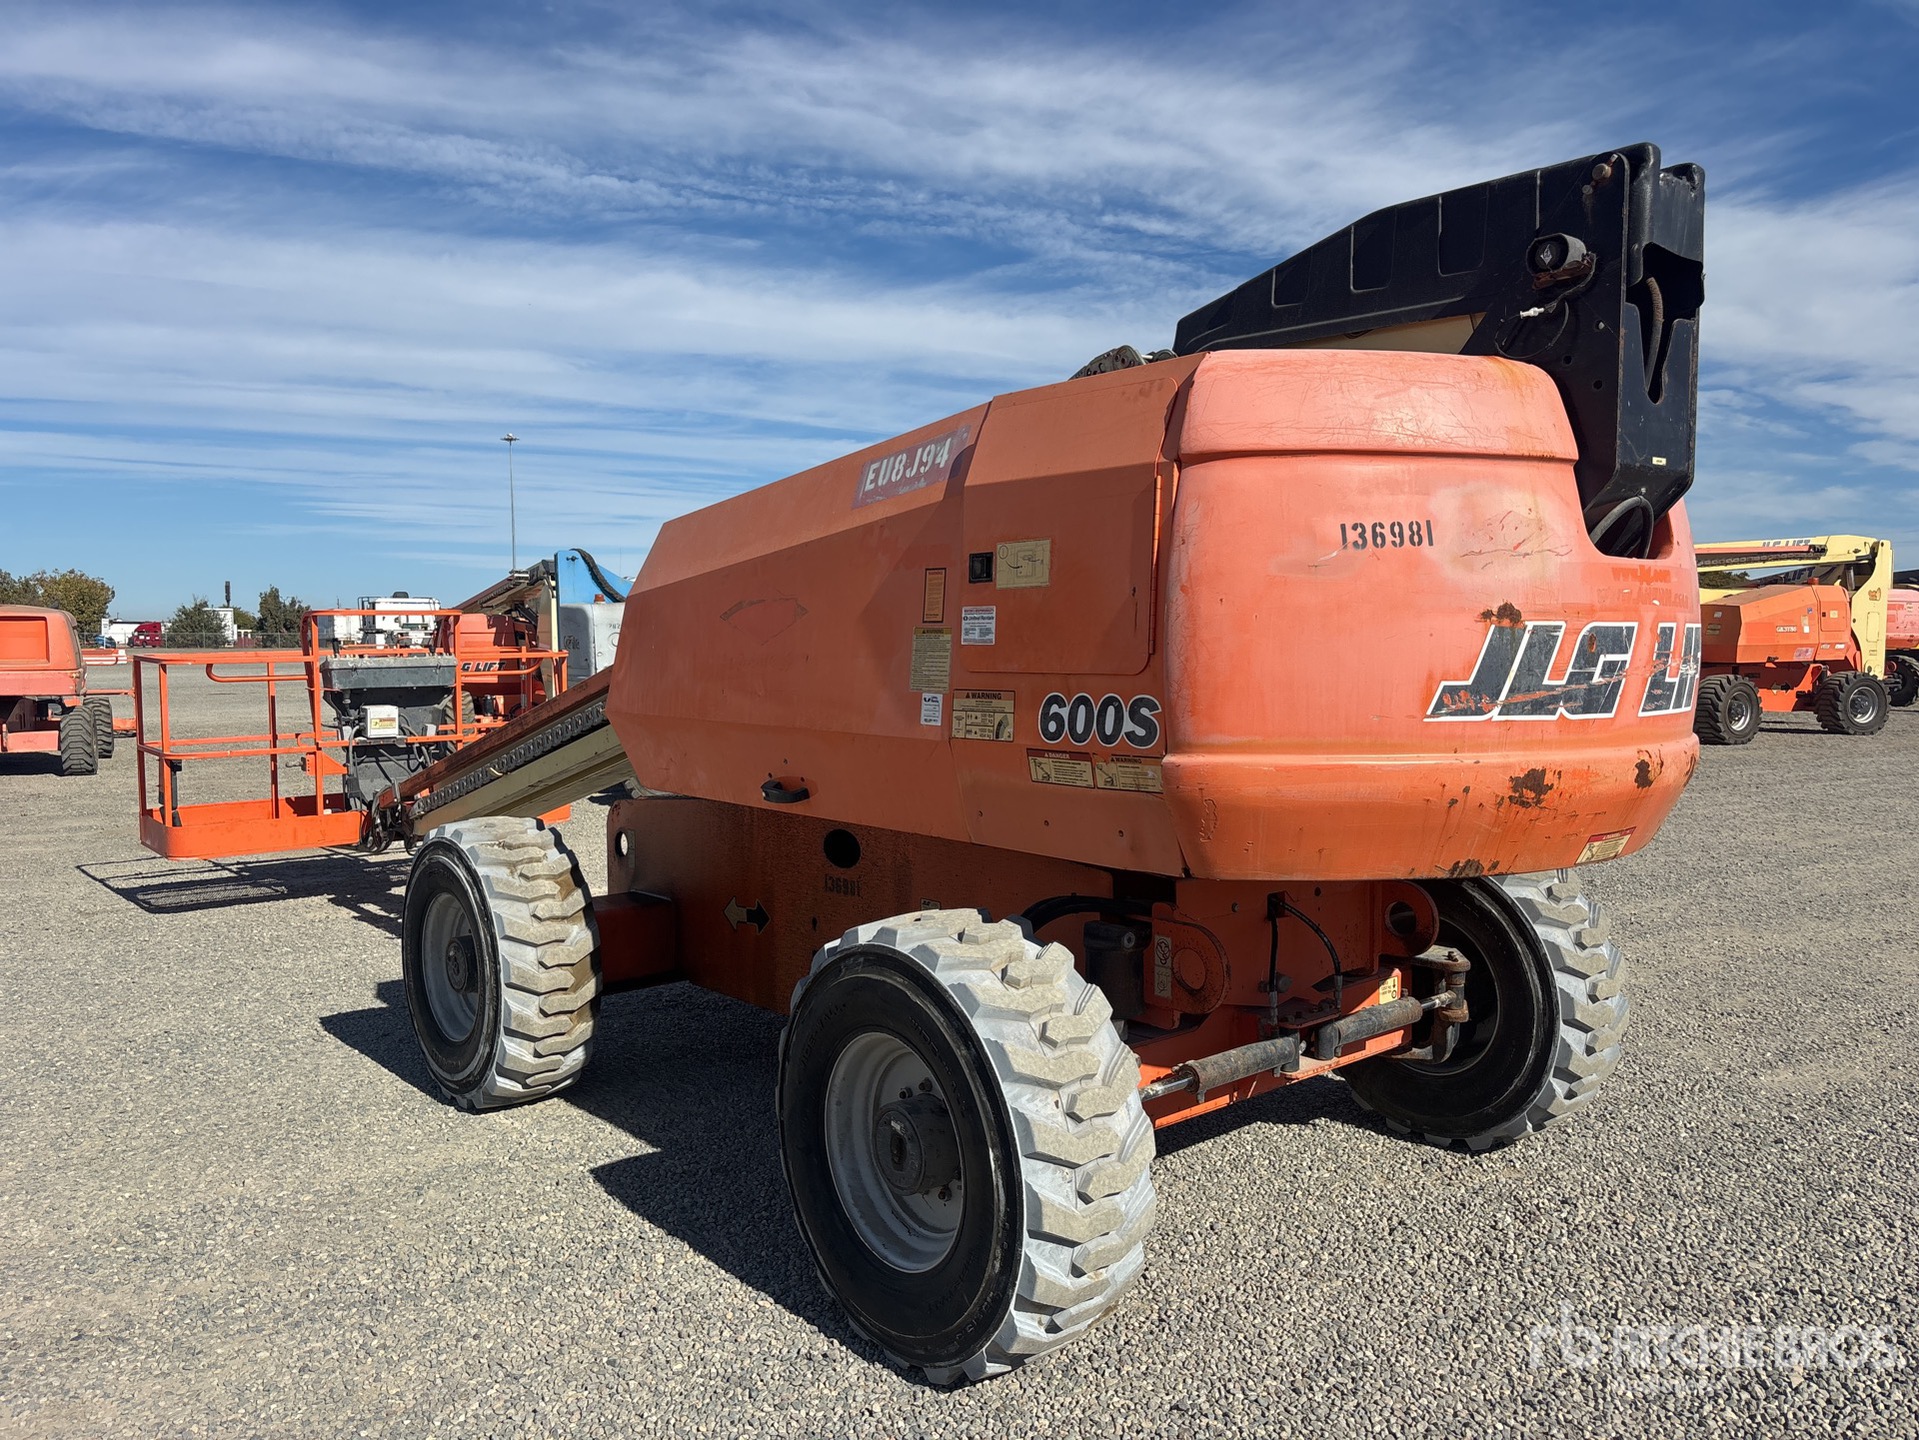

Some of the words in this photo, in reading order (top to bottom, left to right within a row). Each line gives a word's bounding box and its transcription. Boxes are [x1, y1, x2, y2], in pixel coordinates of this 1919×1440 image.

[864, 437, 952, 492] EU8J94
[1339, 519, 1434, 550] 136981
[475, 662, 506, 672] LIFT
[1423, 620, 1639, 722] JLG
[971, 692, 1002, 700] WARNING
[1038, 692, 1162, 749] 600S
